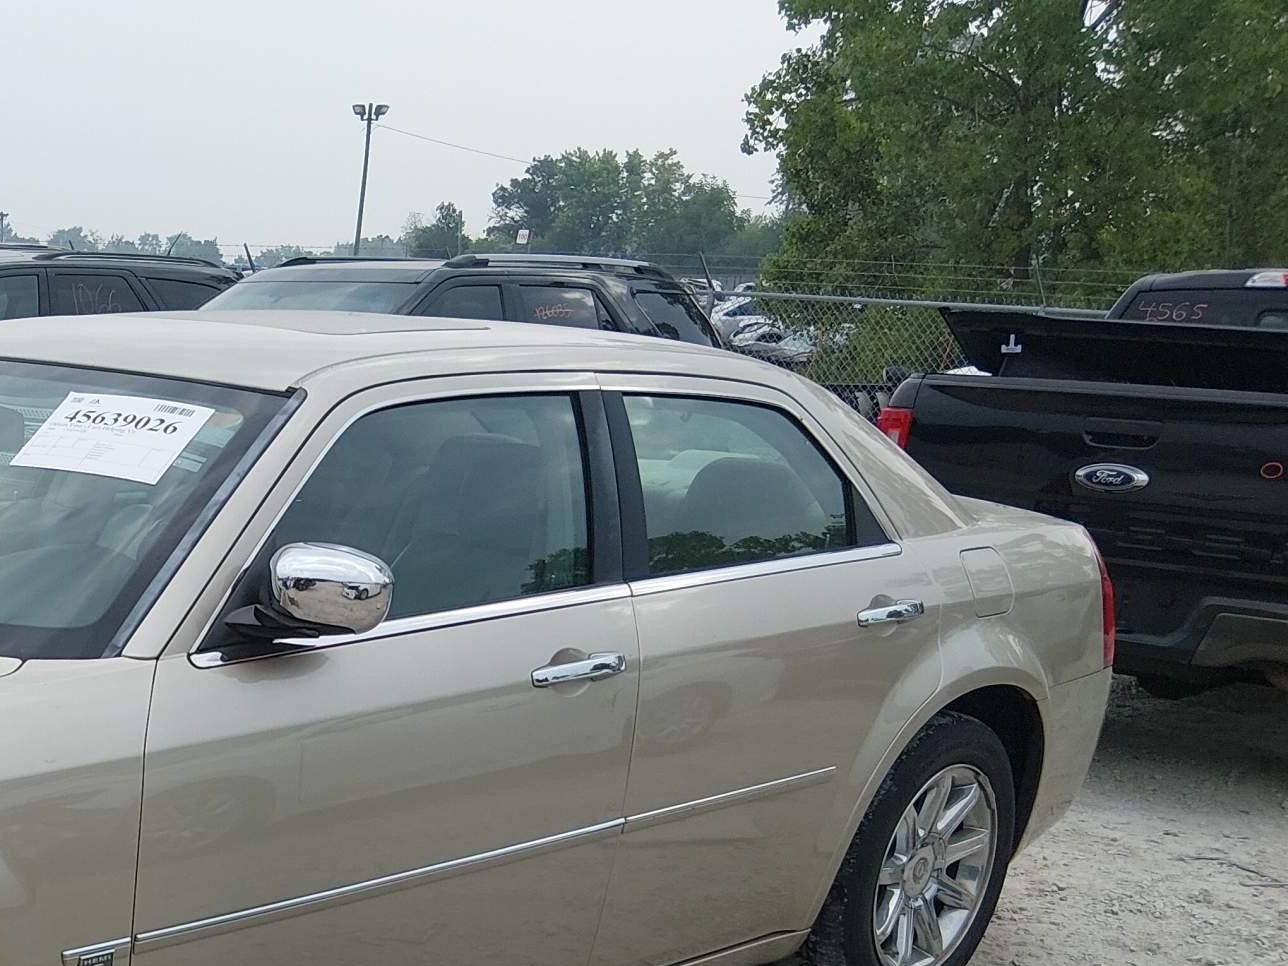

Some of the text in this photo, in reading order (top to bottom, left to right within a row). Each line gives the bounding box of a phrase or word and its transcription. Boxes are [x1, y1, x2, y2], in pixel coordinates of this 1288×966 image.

[1139, 301, 1208, 321] 4565
[64, 409, 185, 435] 45639026
[1092, 470, 1125, 485] Ford
